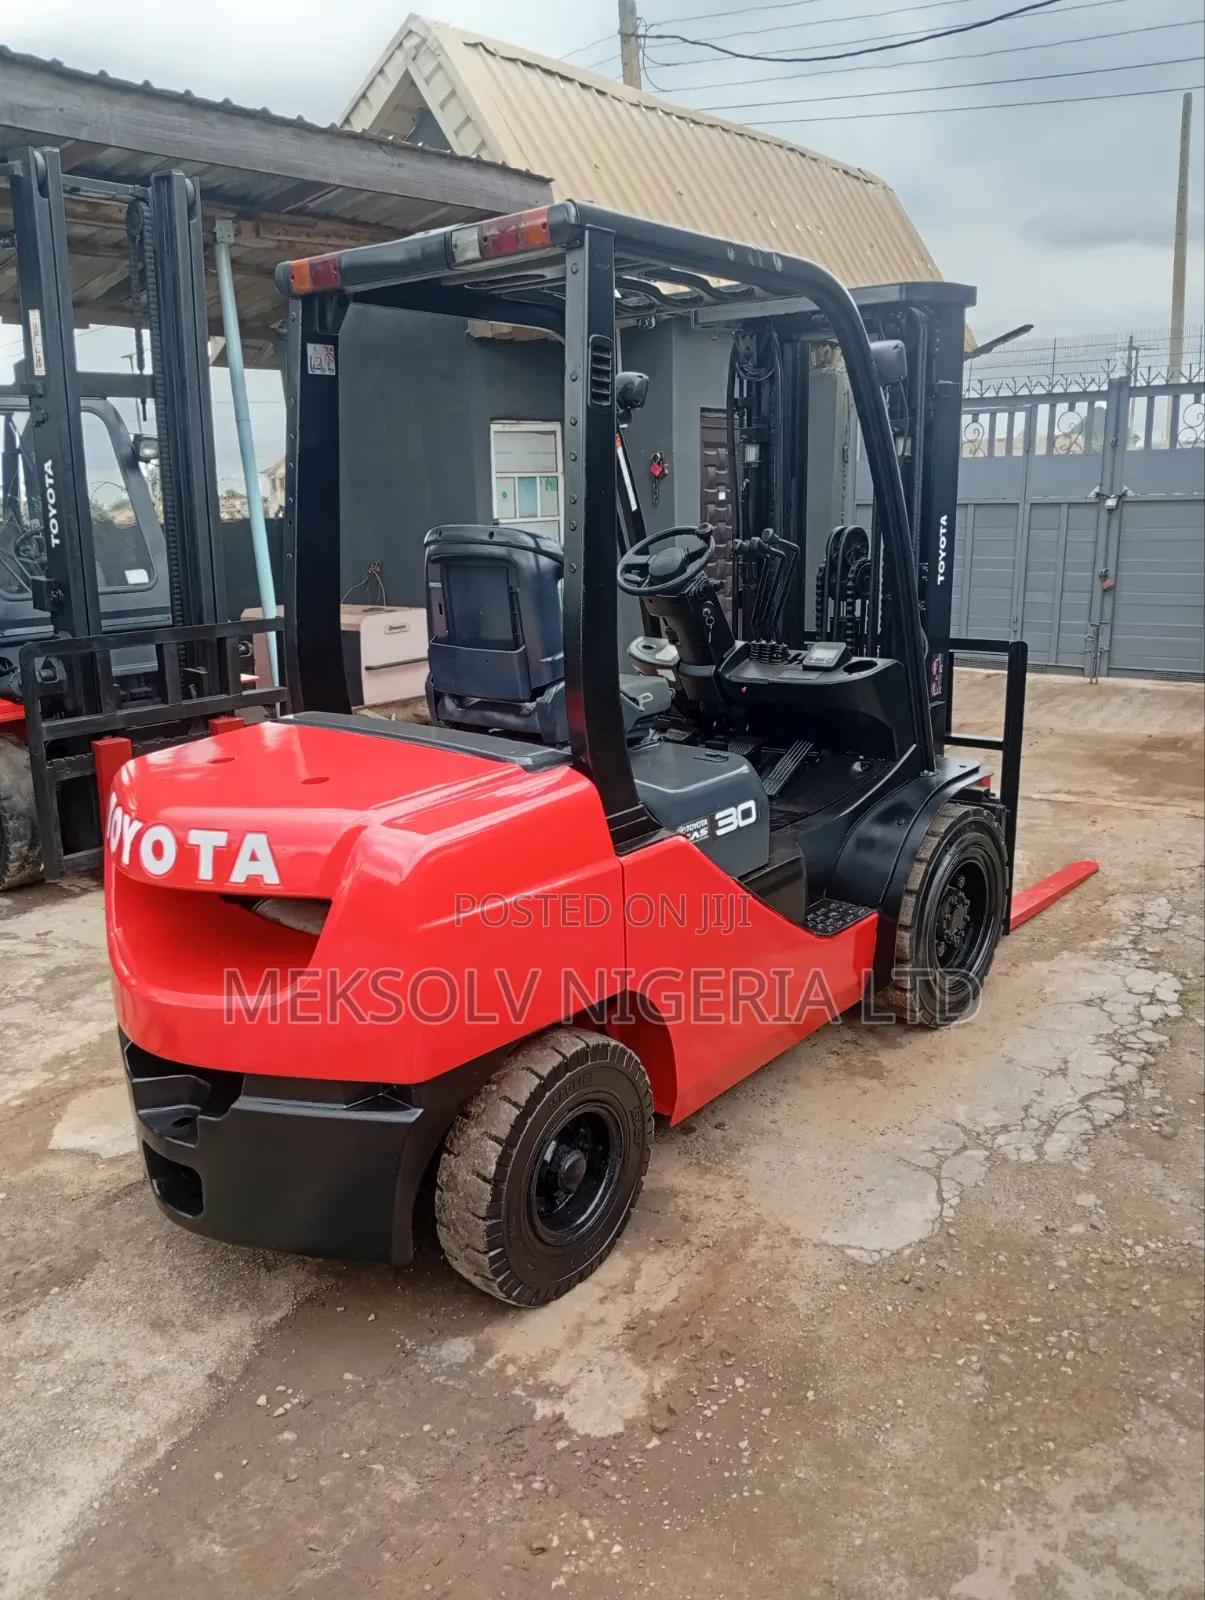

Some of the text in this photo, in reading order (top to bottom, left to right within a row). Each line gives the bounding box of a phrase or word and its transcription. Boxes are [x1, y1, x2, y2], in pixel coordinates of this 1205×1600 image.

[44, 459, 60, 548] TOYOTA
[937, 514, 948, 586] TOYOTA
[686, 818, 708, 834] TOYOTA
[715, 799, 757, 836] 30
